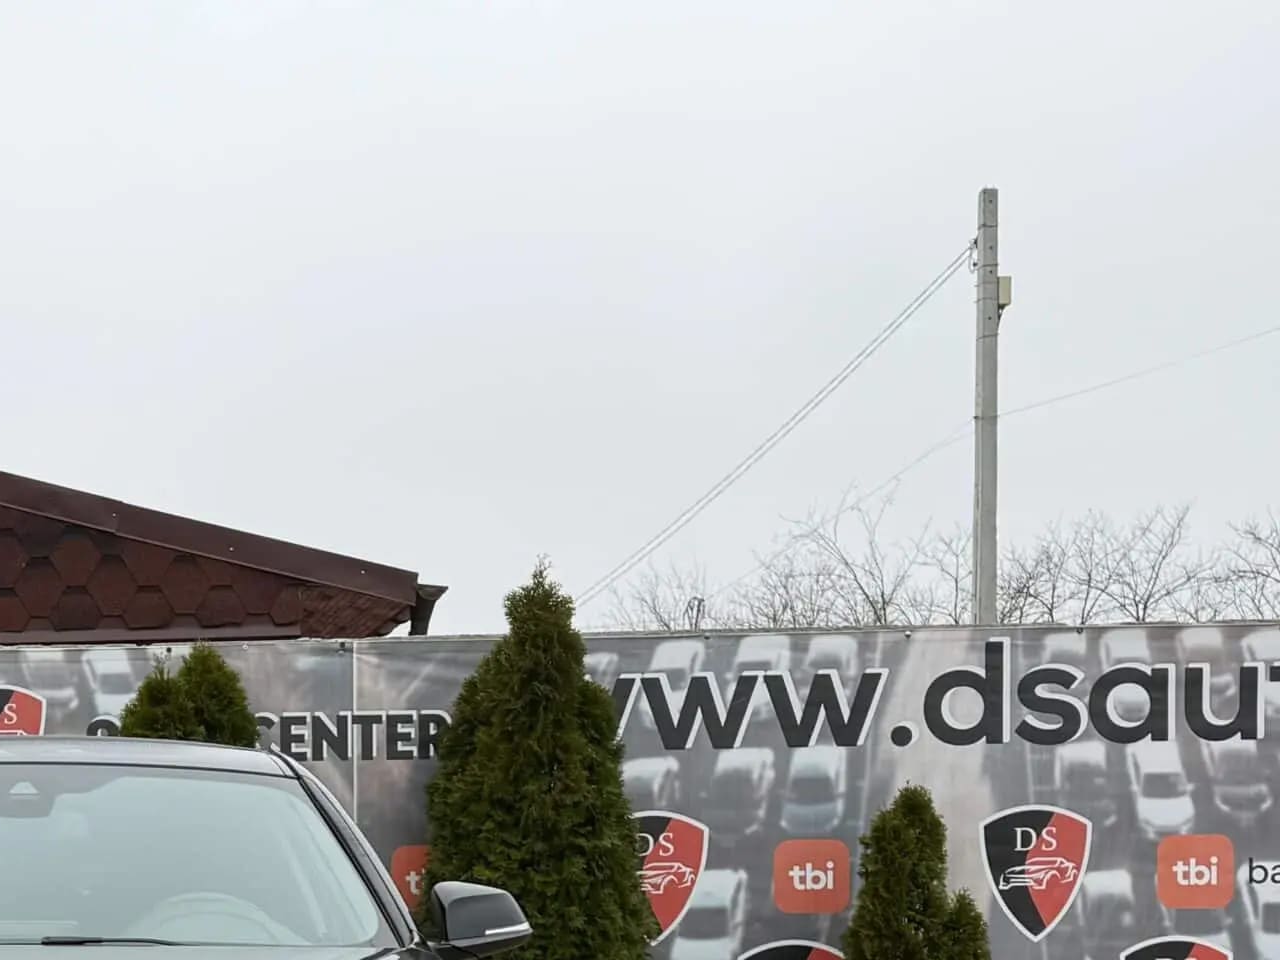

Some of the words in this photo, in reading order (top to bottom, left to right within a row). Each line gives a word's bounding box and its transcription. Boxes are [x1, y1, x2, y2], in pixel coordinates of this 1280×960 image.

[610, 637, 1280, 749] ww.dsau
[1014, 826, 1058, 851] DS
[788, 861, 835, 890] tbi
[1172, 856, 1219, 886] tbi
